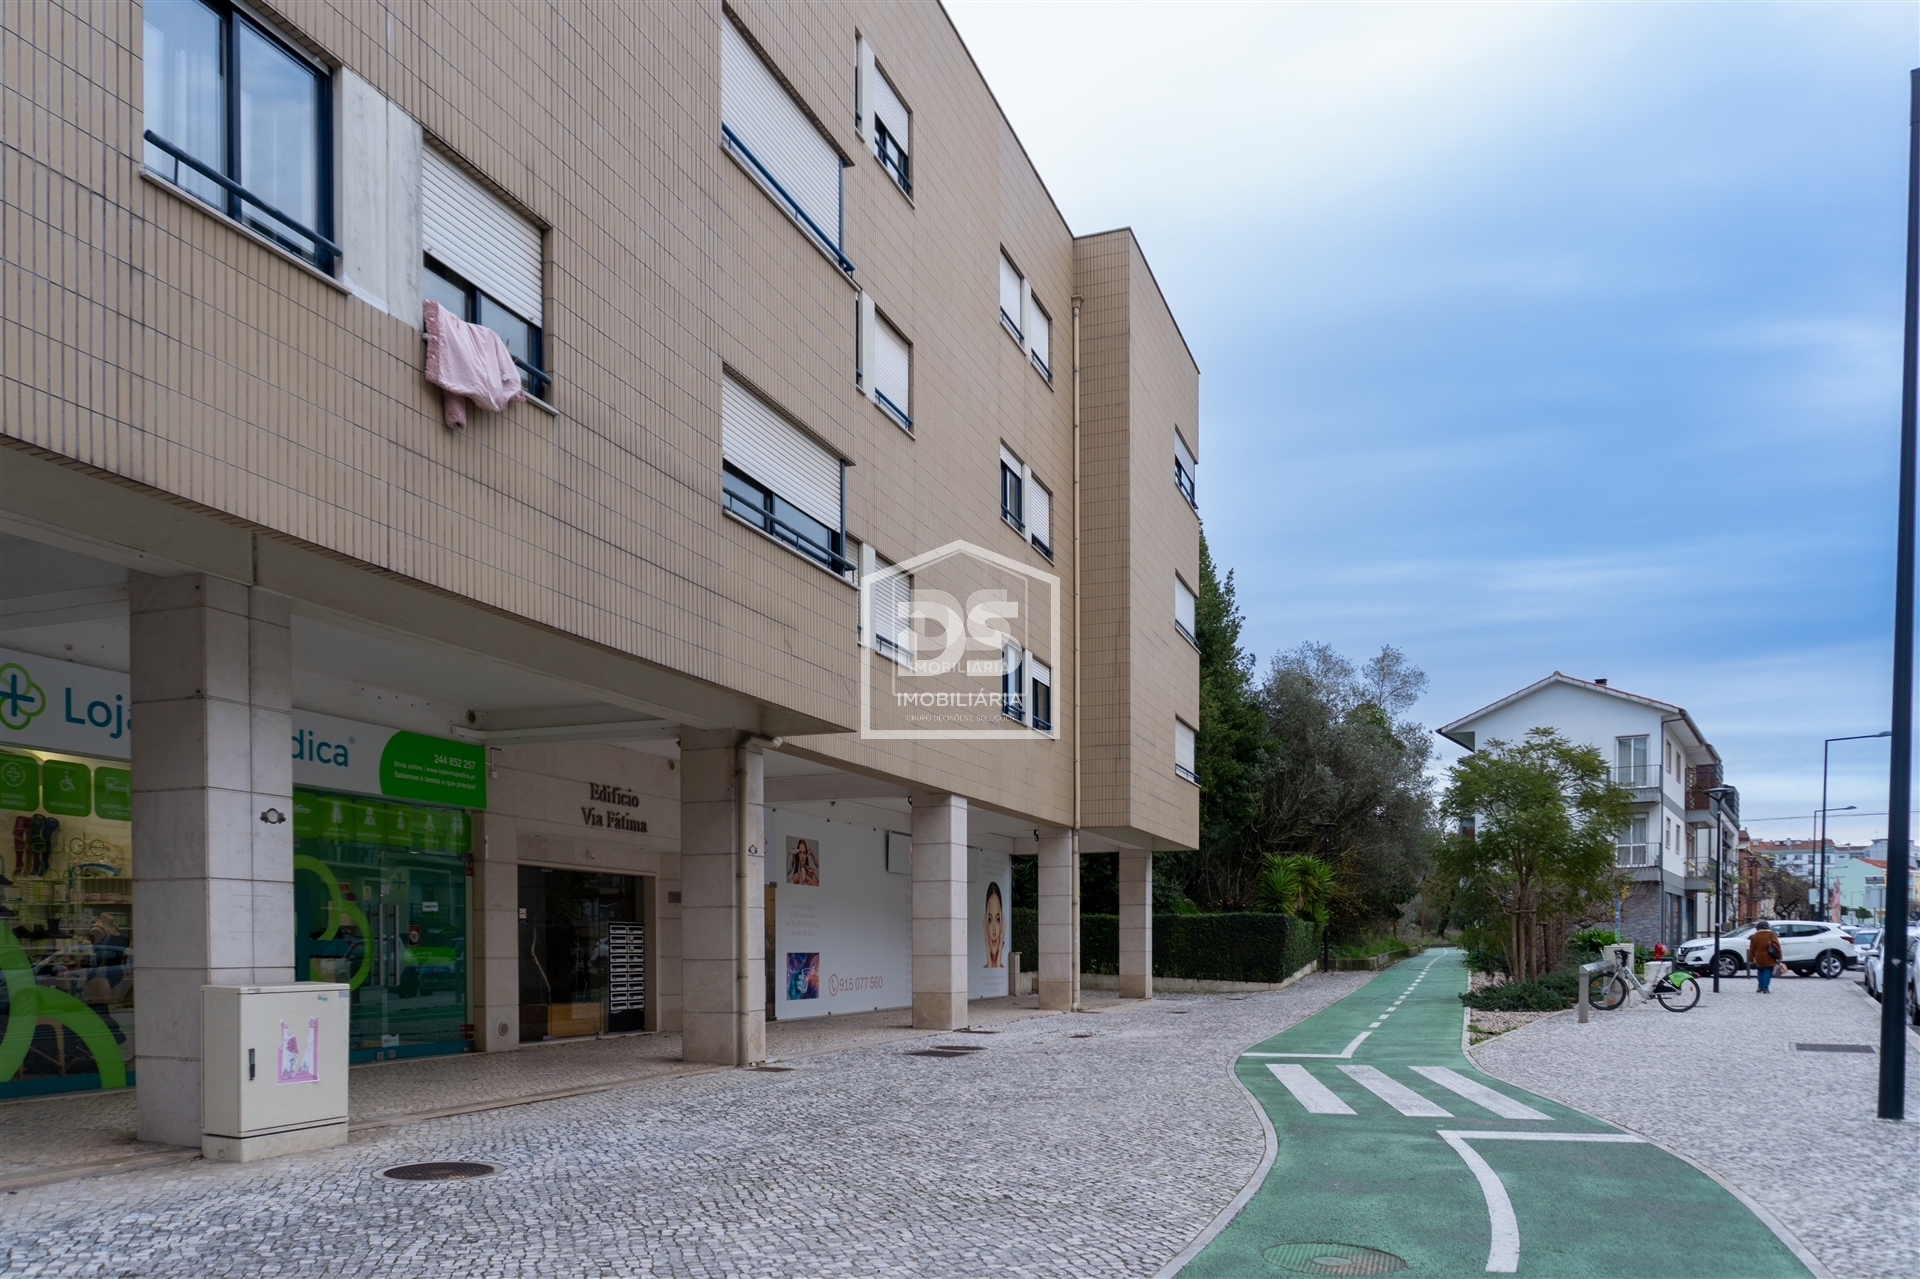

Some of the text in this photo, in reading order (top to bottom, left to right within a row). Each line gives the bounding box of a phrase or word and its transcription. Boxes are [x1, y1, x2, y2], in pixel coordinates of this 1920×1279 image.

[65, 686, 131, 739] Loj
[292, 729, 349, 767] dica
[394, 760, 407, 770] Shop
[408, 763, 423, 772] online
[434, 754, 476, 770] 244 852 257
[394, 770, 419, 781] Sabemos
[425, 776, 441, 785] temos
[581, 807, 648, 833] Via Fátima
[840, 975, 883, 991] 915 077 560
